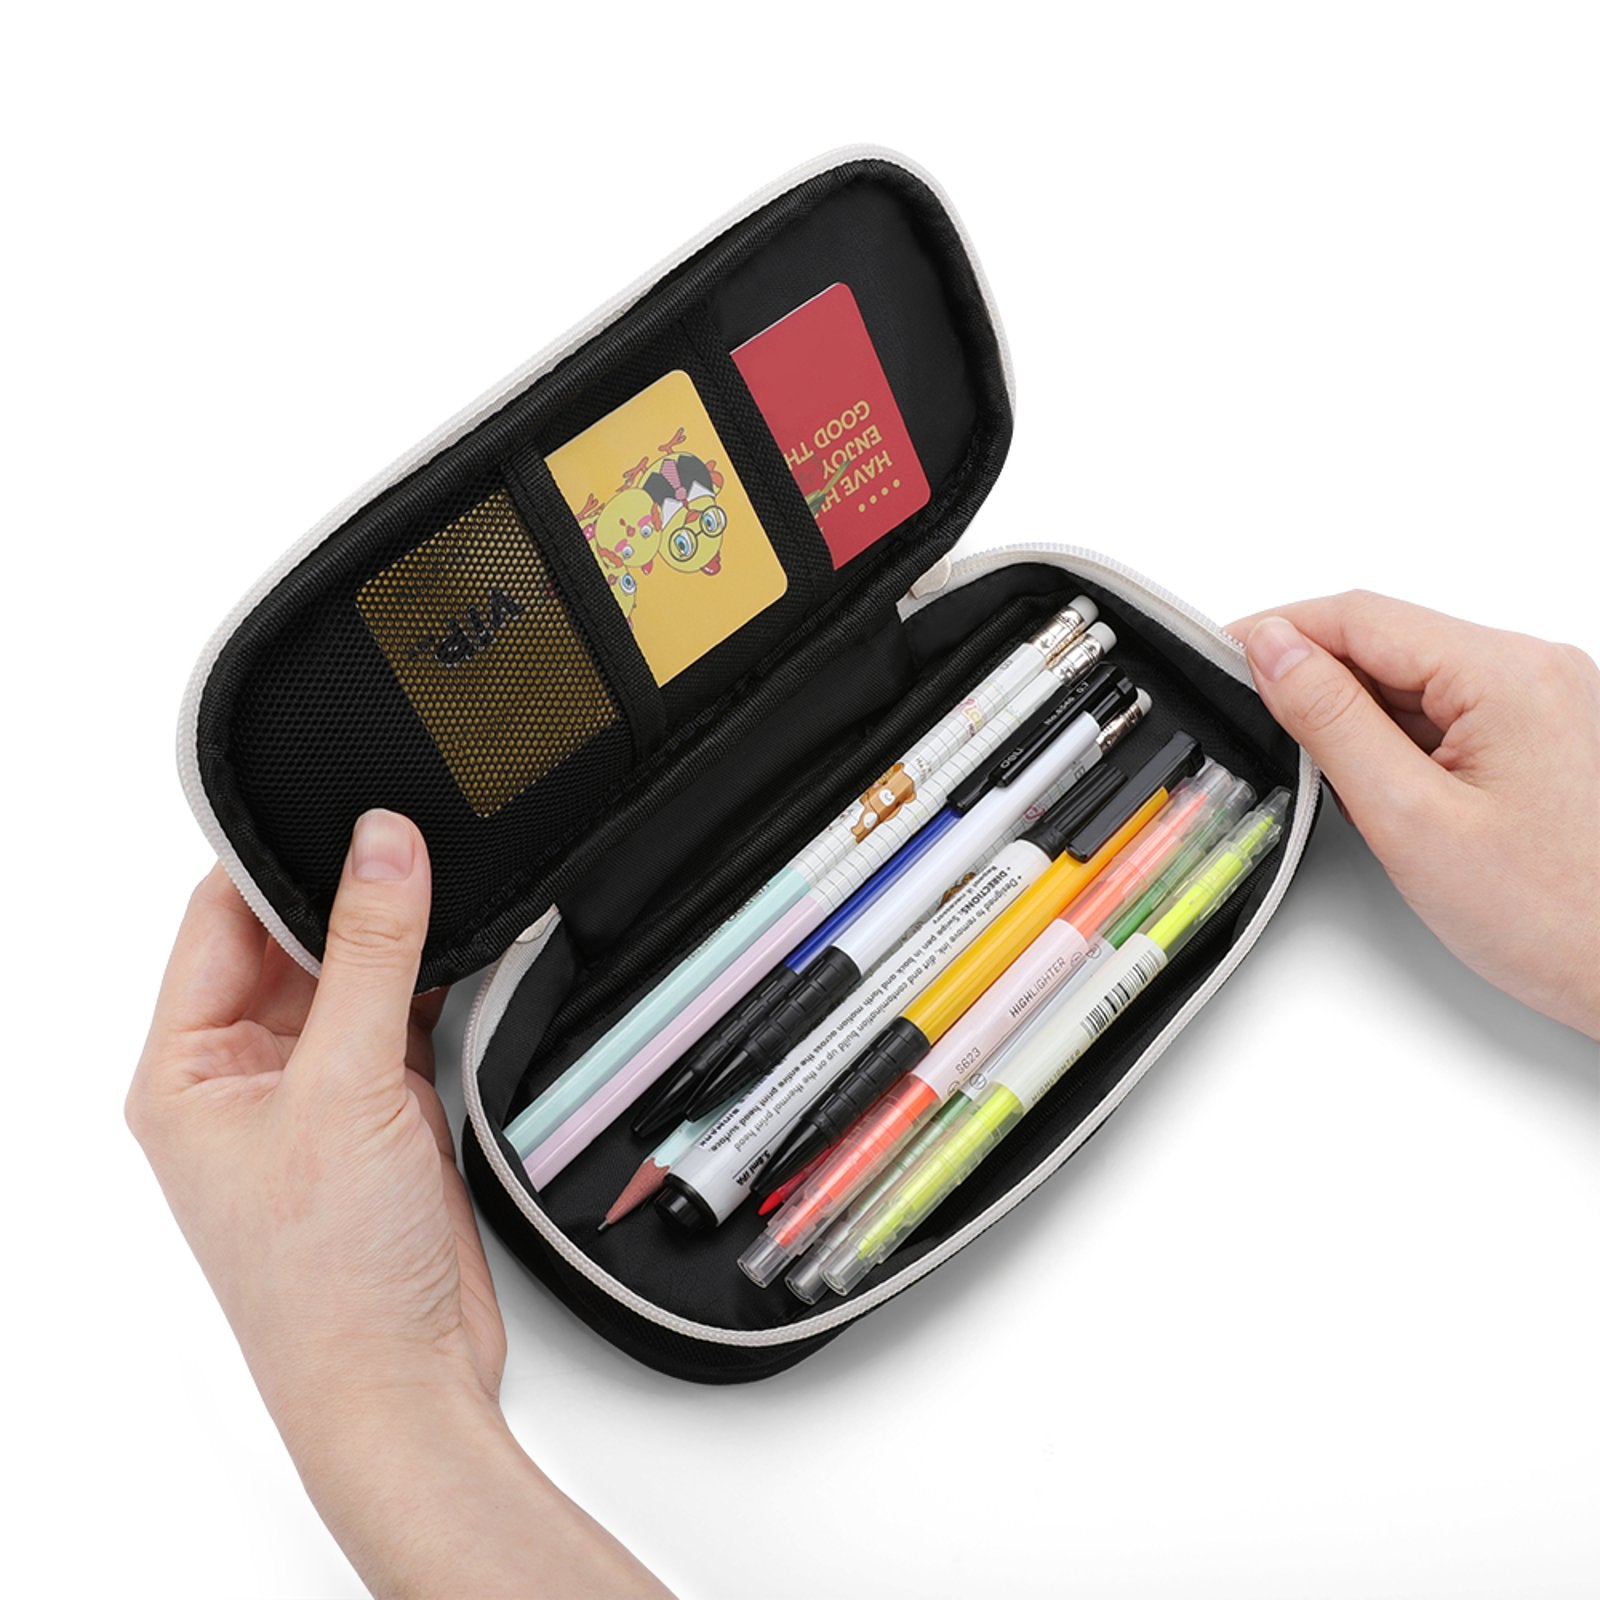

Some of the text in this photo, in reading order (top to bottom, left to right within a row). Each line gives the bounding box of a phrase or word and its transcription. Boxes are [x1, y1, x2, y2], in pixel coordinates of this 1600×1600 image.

[810, 398, 872, 449] GOOD
[818, 423, 882, 480] ENJOY
[838, 448, 893, 496] HAVE
[957, 869, 1008, 917] DIRECTIONS:
[981, 876, 1019, 911] Designed
[935, 912, 960, 938] Swipe
[974, 908, 986, 919] to
[948, 915, 976, 943] remove
[912, 948, 925, 960] in
[920, 933, 938, 951] pen
[895, 957, 913, 975] back
[921, 954, 938, 971] dirt
[880, 972, 898, 990] and
[906, 968, 923, 985] and
[1006, 955, 1067, 1018] HIGHLIGHTER
[855, 981, 909, 1032] contamination
[862, 986, 883, 1008] forth
[836, 1004, 865, 1034] motion
[812, 1028, 838, 1055] across
[836, 1028, 860, 1052] build
[799, 1051, 816, 1069] the
[814, 1058, 828, 1072] on
[824, 1047, 839, 1062] up
[776, 1064, 801, 1089] entire
[801, 1069, 818, 1086] the
[757, 1085, 780, 1108] print
[772, 1082, 805, 1114] thermal
[738, 1103, 762, 1127] head
[752, 1109, 775, 1133] print
[733, 1128, 756, 1152] head
